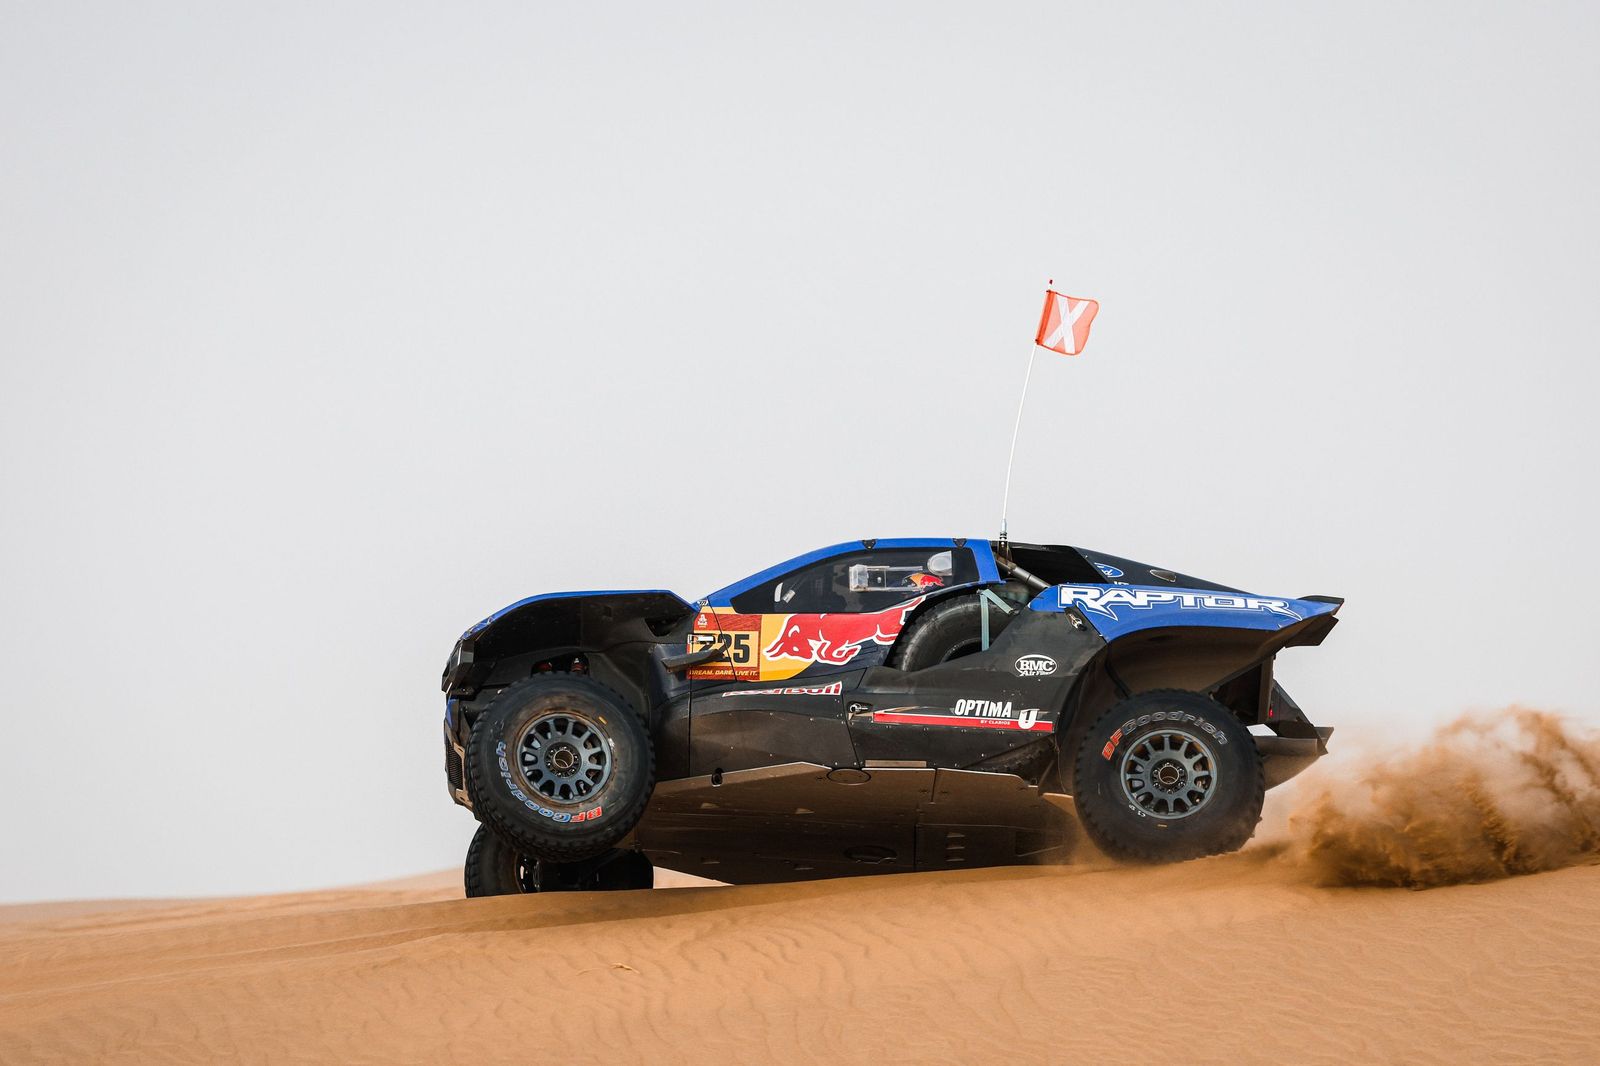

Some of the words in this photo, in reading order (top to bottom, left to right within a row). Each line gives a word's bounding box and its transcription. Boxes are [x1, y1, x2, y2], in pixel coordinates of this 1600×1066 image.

[1058, 586, 1302, 622] RAPTOR
[1020, 660, 1054, 671] BMC
[783, 681, 842, 696] Bull
[954, 699, 1012, 718] OPTIMA
[1101, 710, 1228, 761] BFGoodrich
[495, 741, 603, 823] BFGoodrich
